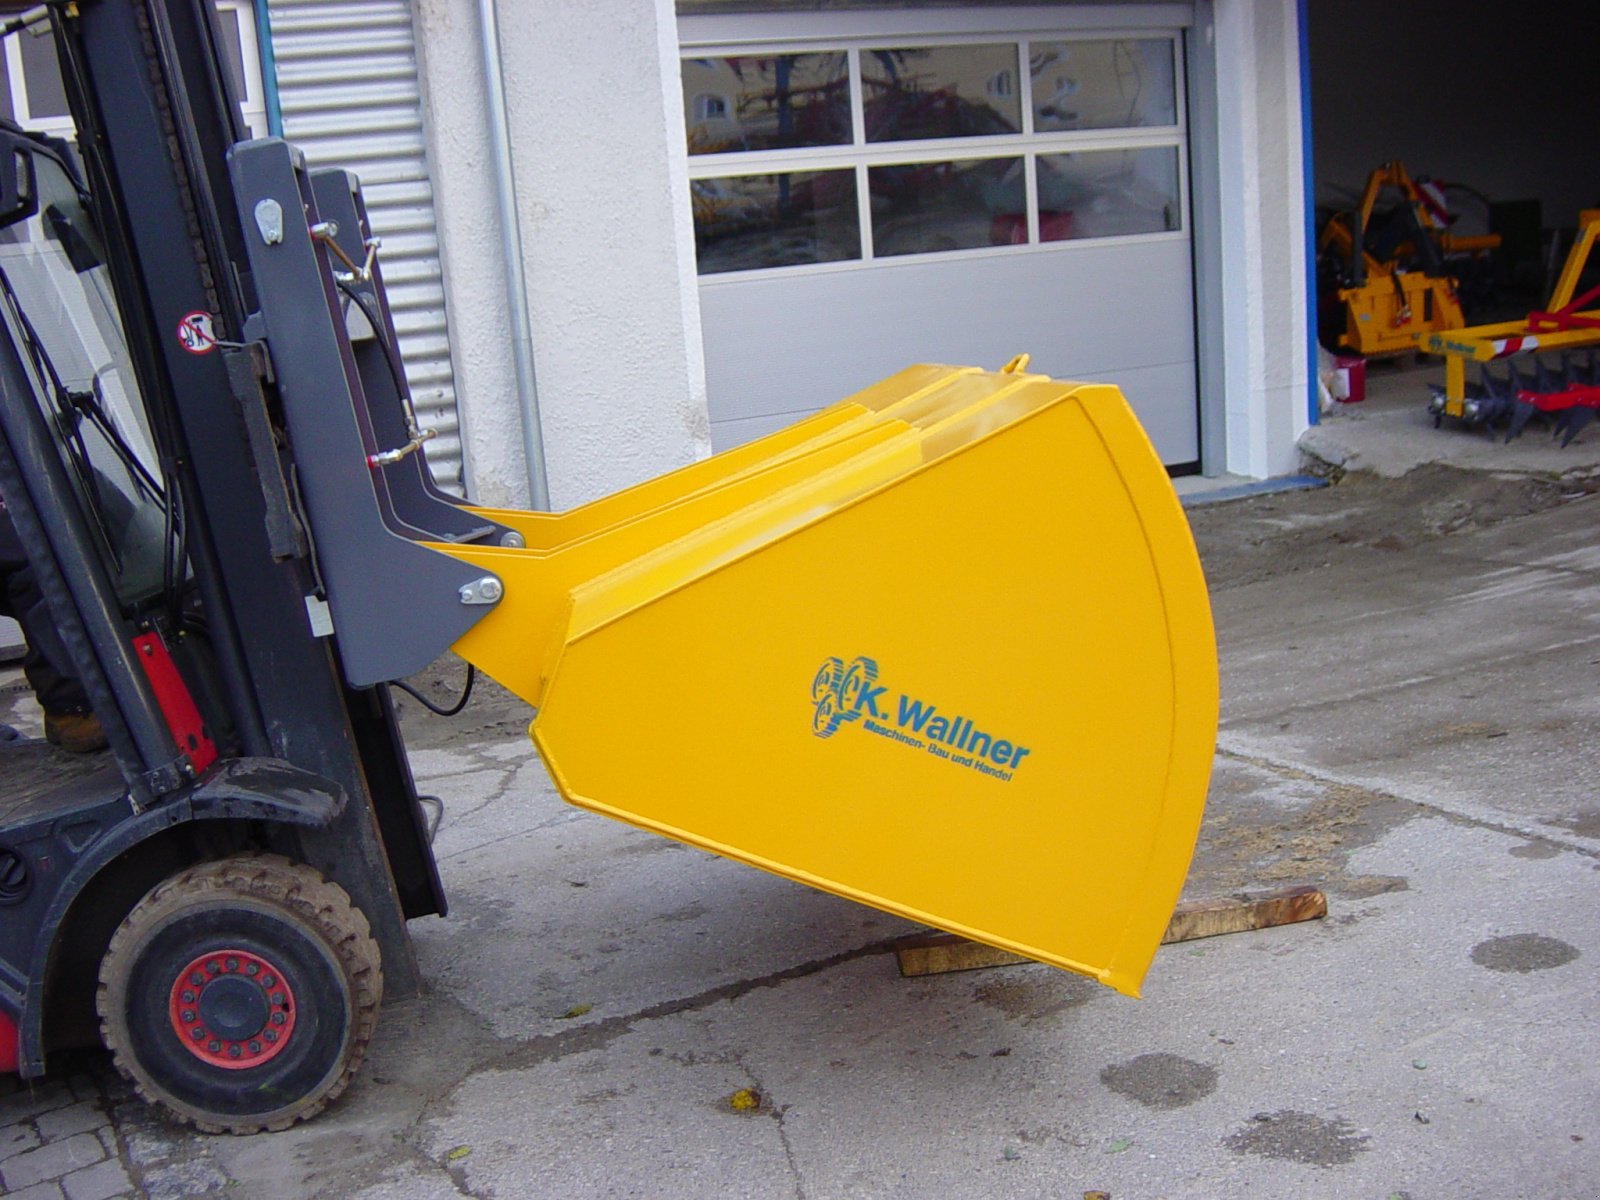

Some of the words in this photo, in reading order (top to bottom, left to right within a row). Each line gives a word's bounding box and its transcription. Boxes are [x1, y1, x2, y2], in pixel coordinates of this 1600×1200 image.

[854, 681, 889, 720] K.
[898, 695, 1030, 769] Wallner
[863, 719, 926, 749] Maschinen-
[928, 743, 949, 759] Bau
[951, 752, 972, 768] und
[974, 757, 1013, 782] Handel
